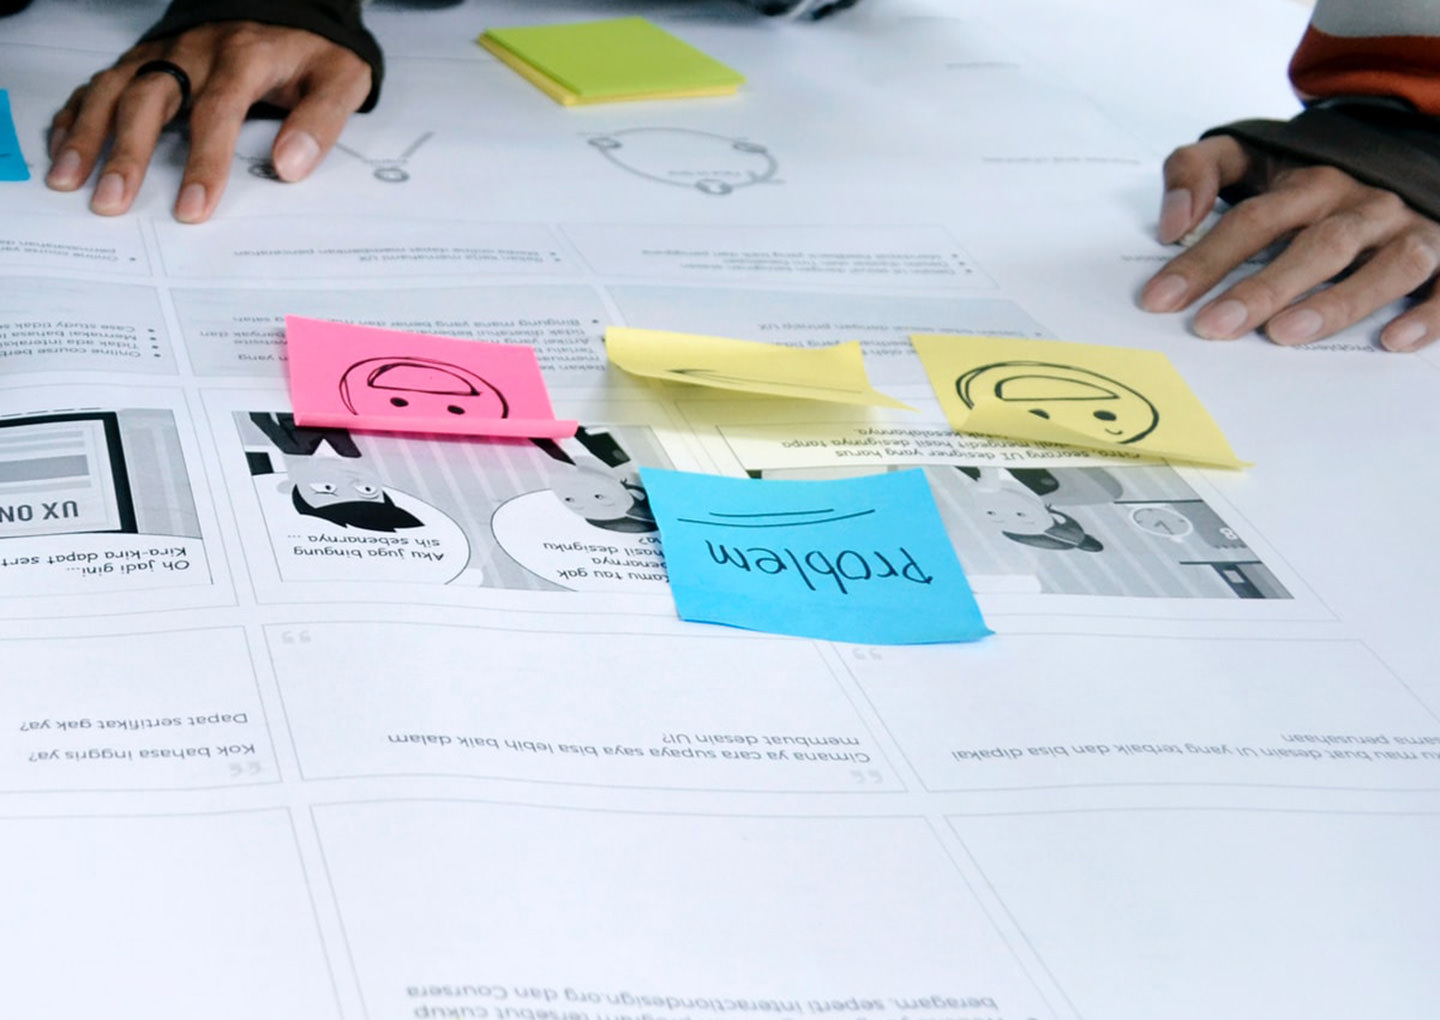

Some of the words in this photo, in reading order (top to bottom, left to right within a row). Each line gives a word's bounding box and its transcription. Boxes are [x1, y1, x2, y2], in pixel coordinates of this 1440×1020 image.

[14, 322, 52, 331] tidak
[56, 321, 96, 330] study
[99, 324, 135, 333] Case
[11, 330, 65, 339] bahasa
[69, 331, 137, 341] Memakai
[0, 339, 62, 348] interaksi
[66, 339, 94, 347] ada
[98, 340, 139, 349] Tidak
[37, 347, 87, 355] course
[90, 348, 141, 358] Online
[40, 500, 79, 521] UX
[307, 533, 410, 546] sebenarnya
[413, 537, 441, 548] sih
[104, 546, 188, 562] Kira-kira
[292, 545, 363, 559] bingung
[366, 547, 405, 560] juga
[541, 541, 619, 555] designku
[45, 551, 99, 564] dapat
[410, 550, 445, 561] Aku
[119, 559, 156, 575] jadi
[161, 559, 191, 571] Oh
[556, 567, 589, 580] gak
[592, 569, 622, 580] tau
[19, 718, 53, 733] ya?
[56, 717, 94, 732] gak
[95, 716, 183, 730] sertifikat
[186, 712, 249, 726] Dapat
[387, 734, 453, 747] dalam
[456, 736, 501, 750] baik
[694, 733, 759, 747] desain
[761, 734, 861, 747] membuat
[1279, 733, 1390, 746] perusahaan
[138, 746, 212, 760] bahasa
[216, 743, 256, 757] Kok
[504, 739, 555, 754] lebih
[557, 744, 599, 757] bisa
[601, 744, 644, 757] saya
[649, 746, 718, 759] supaya
[1027, 746, 1071, 758] bisa
[1071, 744, 1112, 757] dan
[1112, 744, 1183, 757] terbaik
[1184, 743, 1234, 755] yang
[28, 748, 60, 763] ya?
[64, 747, 133, 762] inggris
[720, 750, 762, 760] cara
[765, 749, 790, 761] ya
[951, 747, 1024, 762] dipakai
[1259, 748, 1323, 760] desain
[405, 985, 508, 1000] Coursera
[515, 987, 558, 1002] dan
[563, 987, 803, 1014] interactiondesign.org
[807, 998, 886, 1013] seperti
